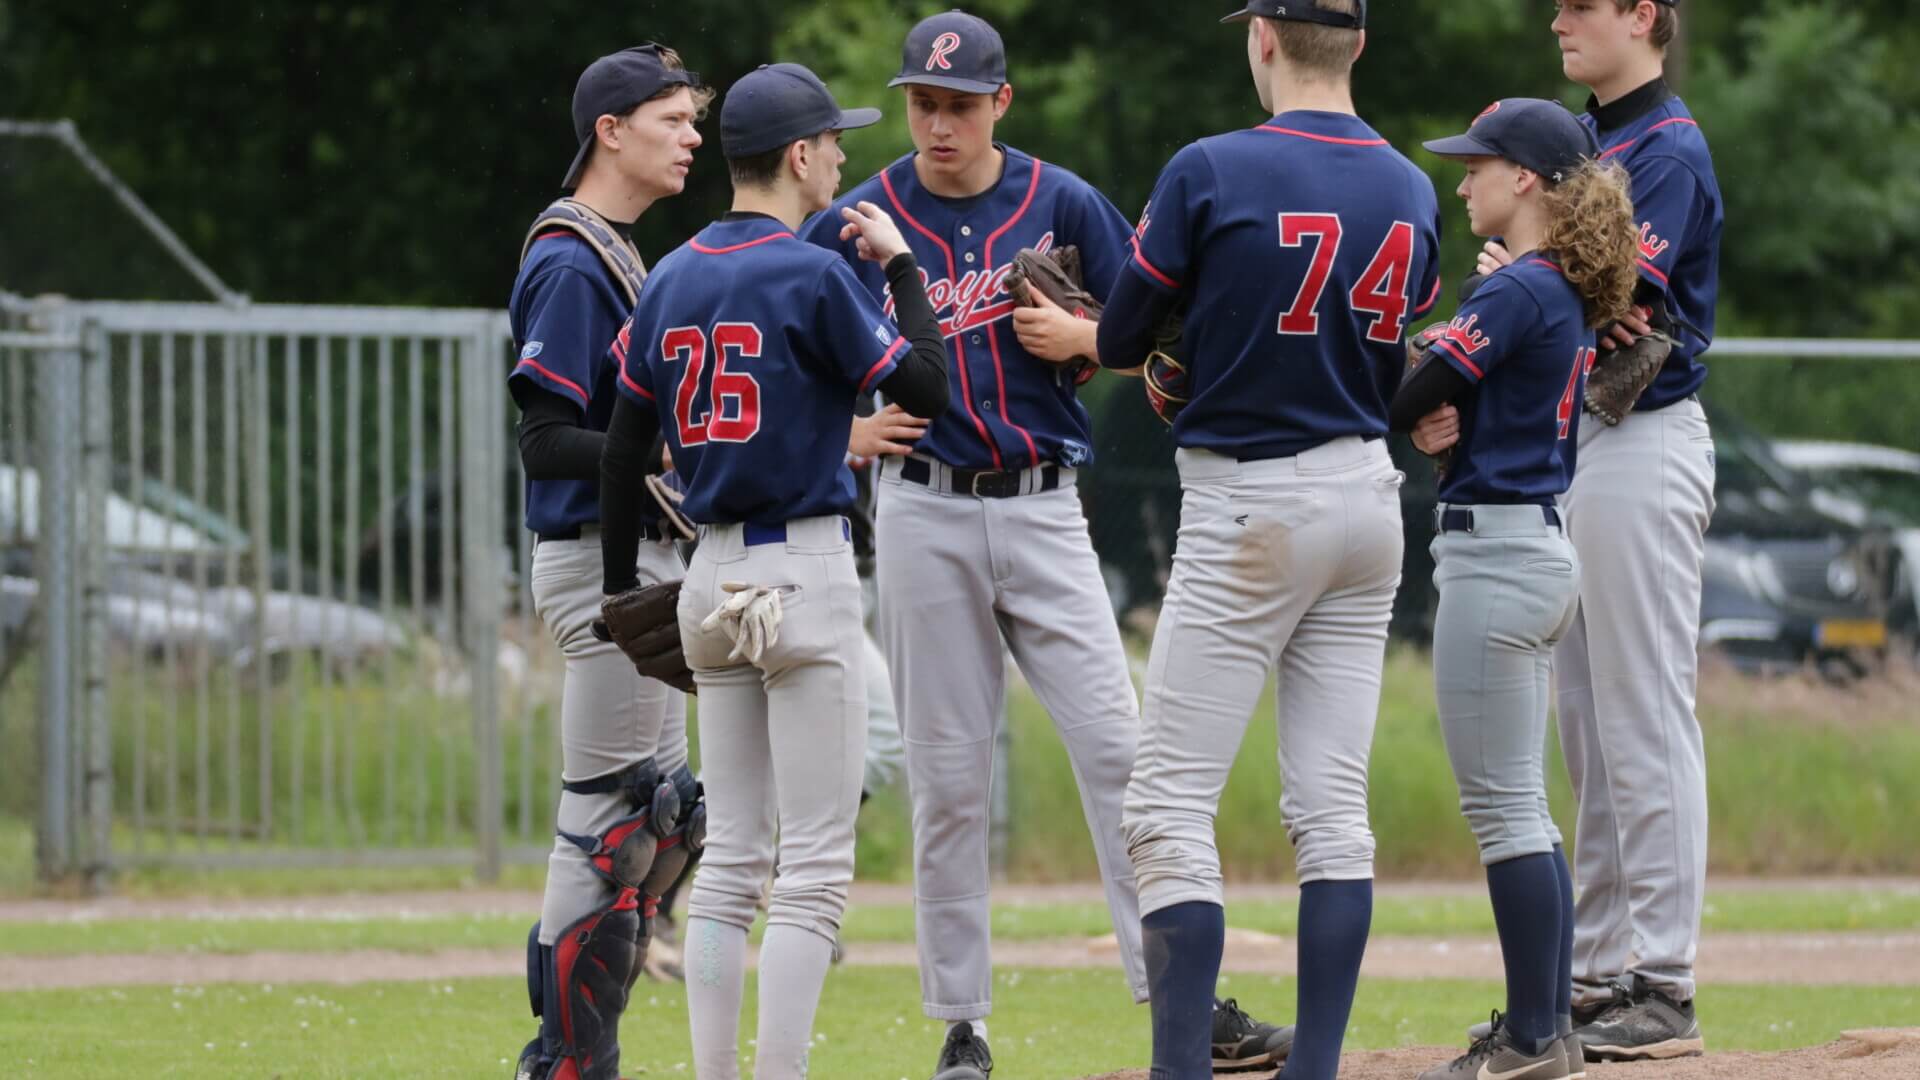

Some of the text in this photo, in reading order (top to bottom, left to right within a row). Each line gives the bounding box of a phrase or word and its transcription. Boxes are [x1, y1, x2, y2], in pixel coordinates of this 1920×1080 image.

[925, 31, 960, 71] R
[1277, 212, 1414, 344] 74
[661, 321, 763, 448] 26
